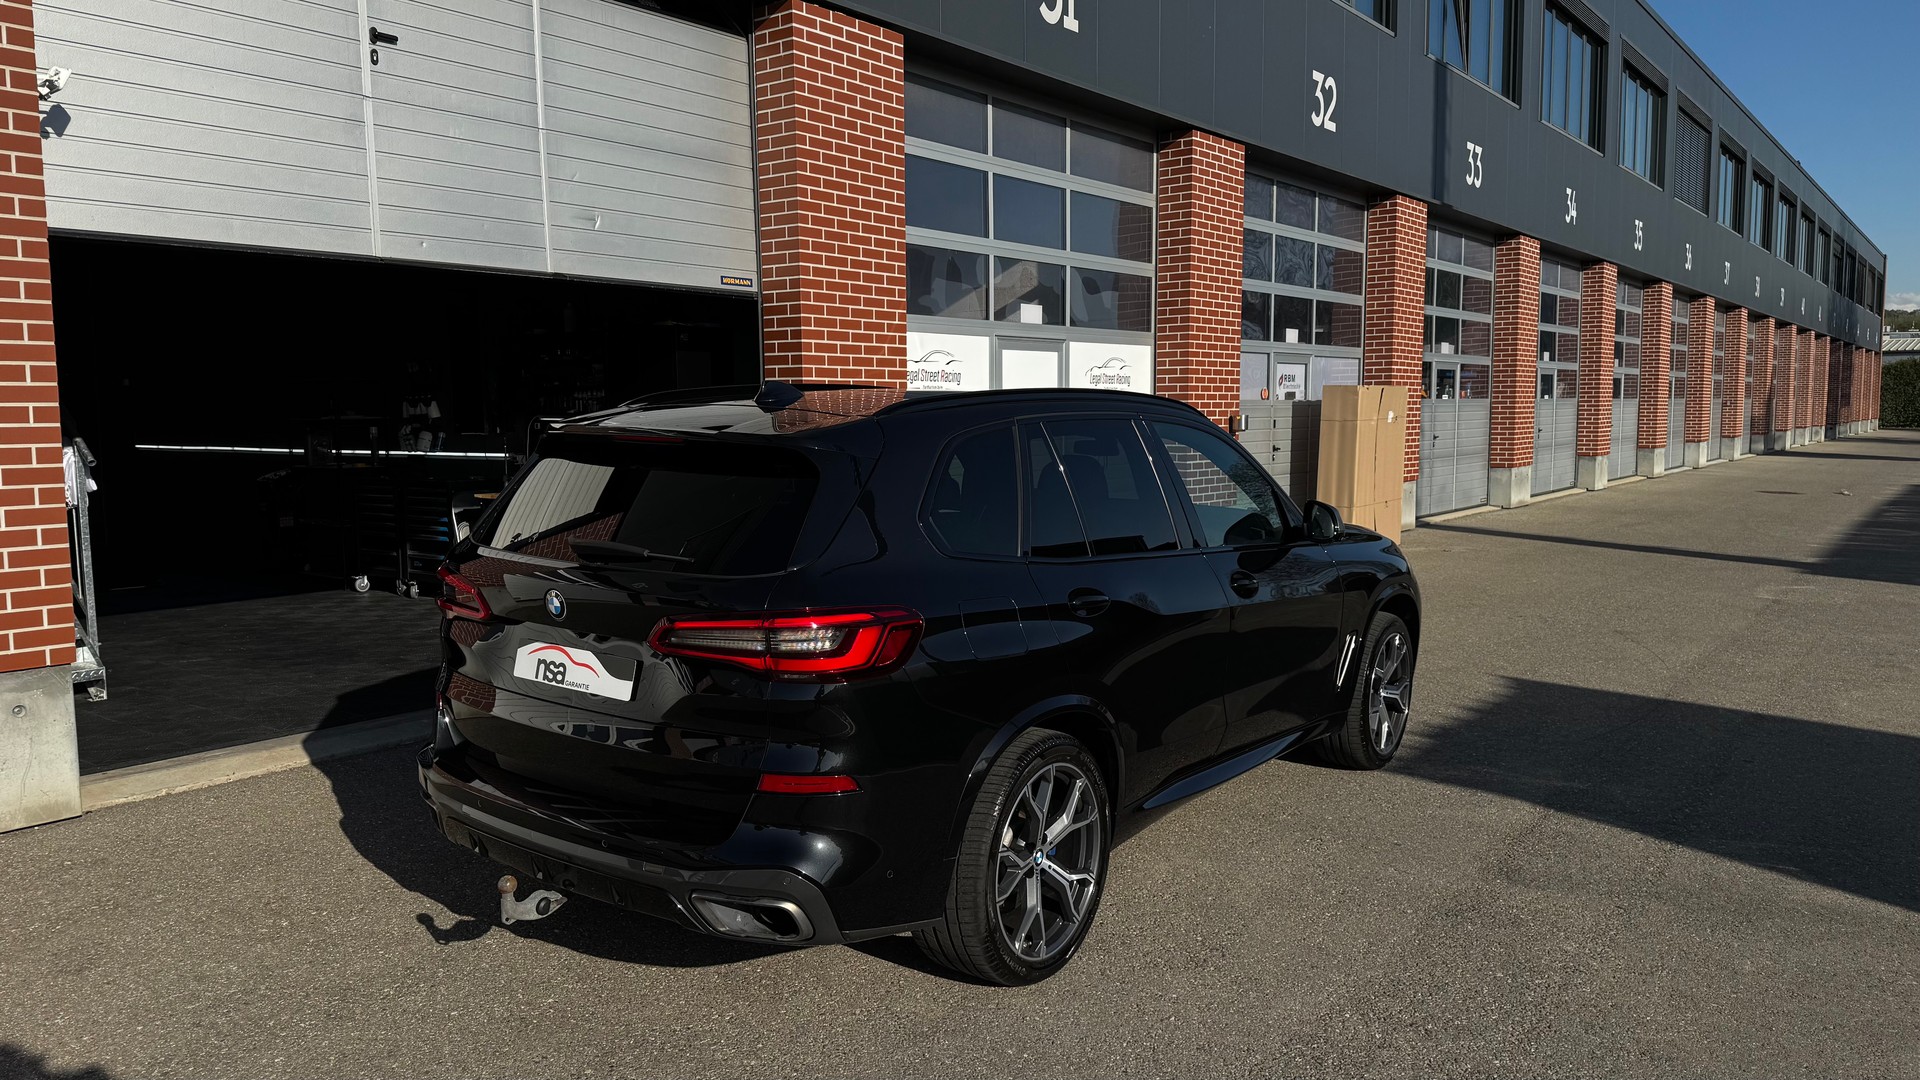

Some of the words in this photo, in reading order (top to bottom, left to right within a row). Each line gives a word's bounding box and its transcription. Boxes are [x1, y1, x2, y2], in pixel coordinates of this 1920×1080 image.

[1311, 69, 1337, 133] 32
[1465, 141, 1483, 189] 33
[1565, 187, 1577, 225] 34
[1634, 219, 1643, 252] 35
[907, 368, 920, 384] egal
[920, 369, 940, 382] Street
[940, 369, 962, 385] Racing
[1089, 372, 1102, 386] Legal
[1102, 373, 1115, 384] Street
[1116, 373, 1131, 387] Racing
[1284, 374, 1296, 383] RBM
[535, 658, 567, 685] nsa
[565, 680, 590, 691] GARANTIE
